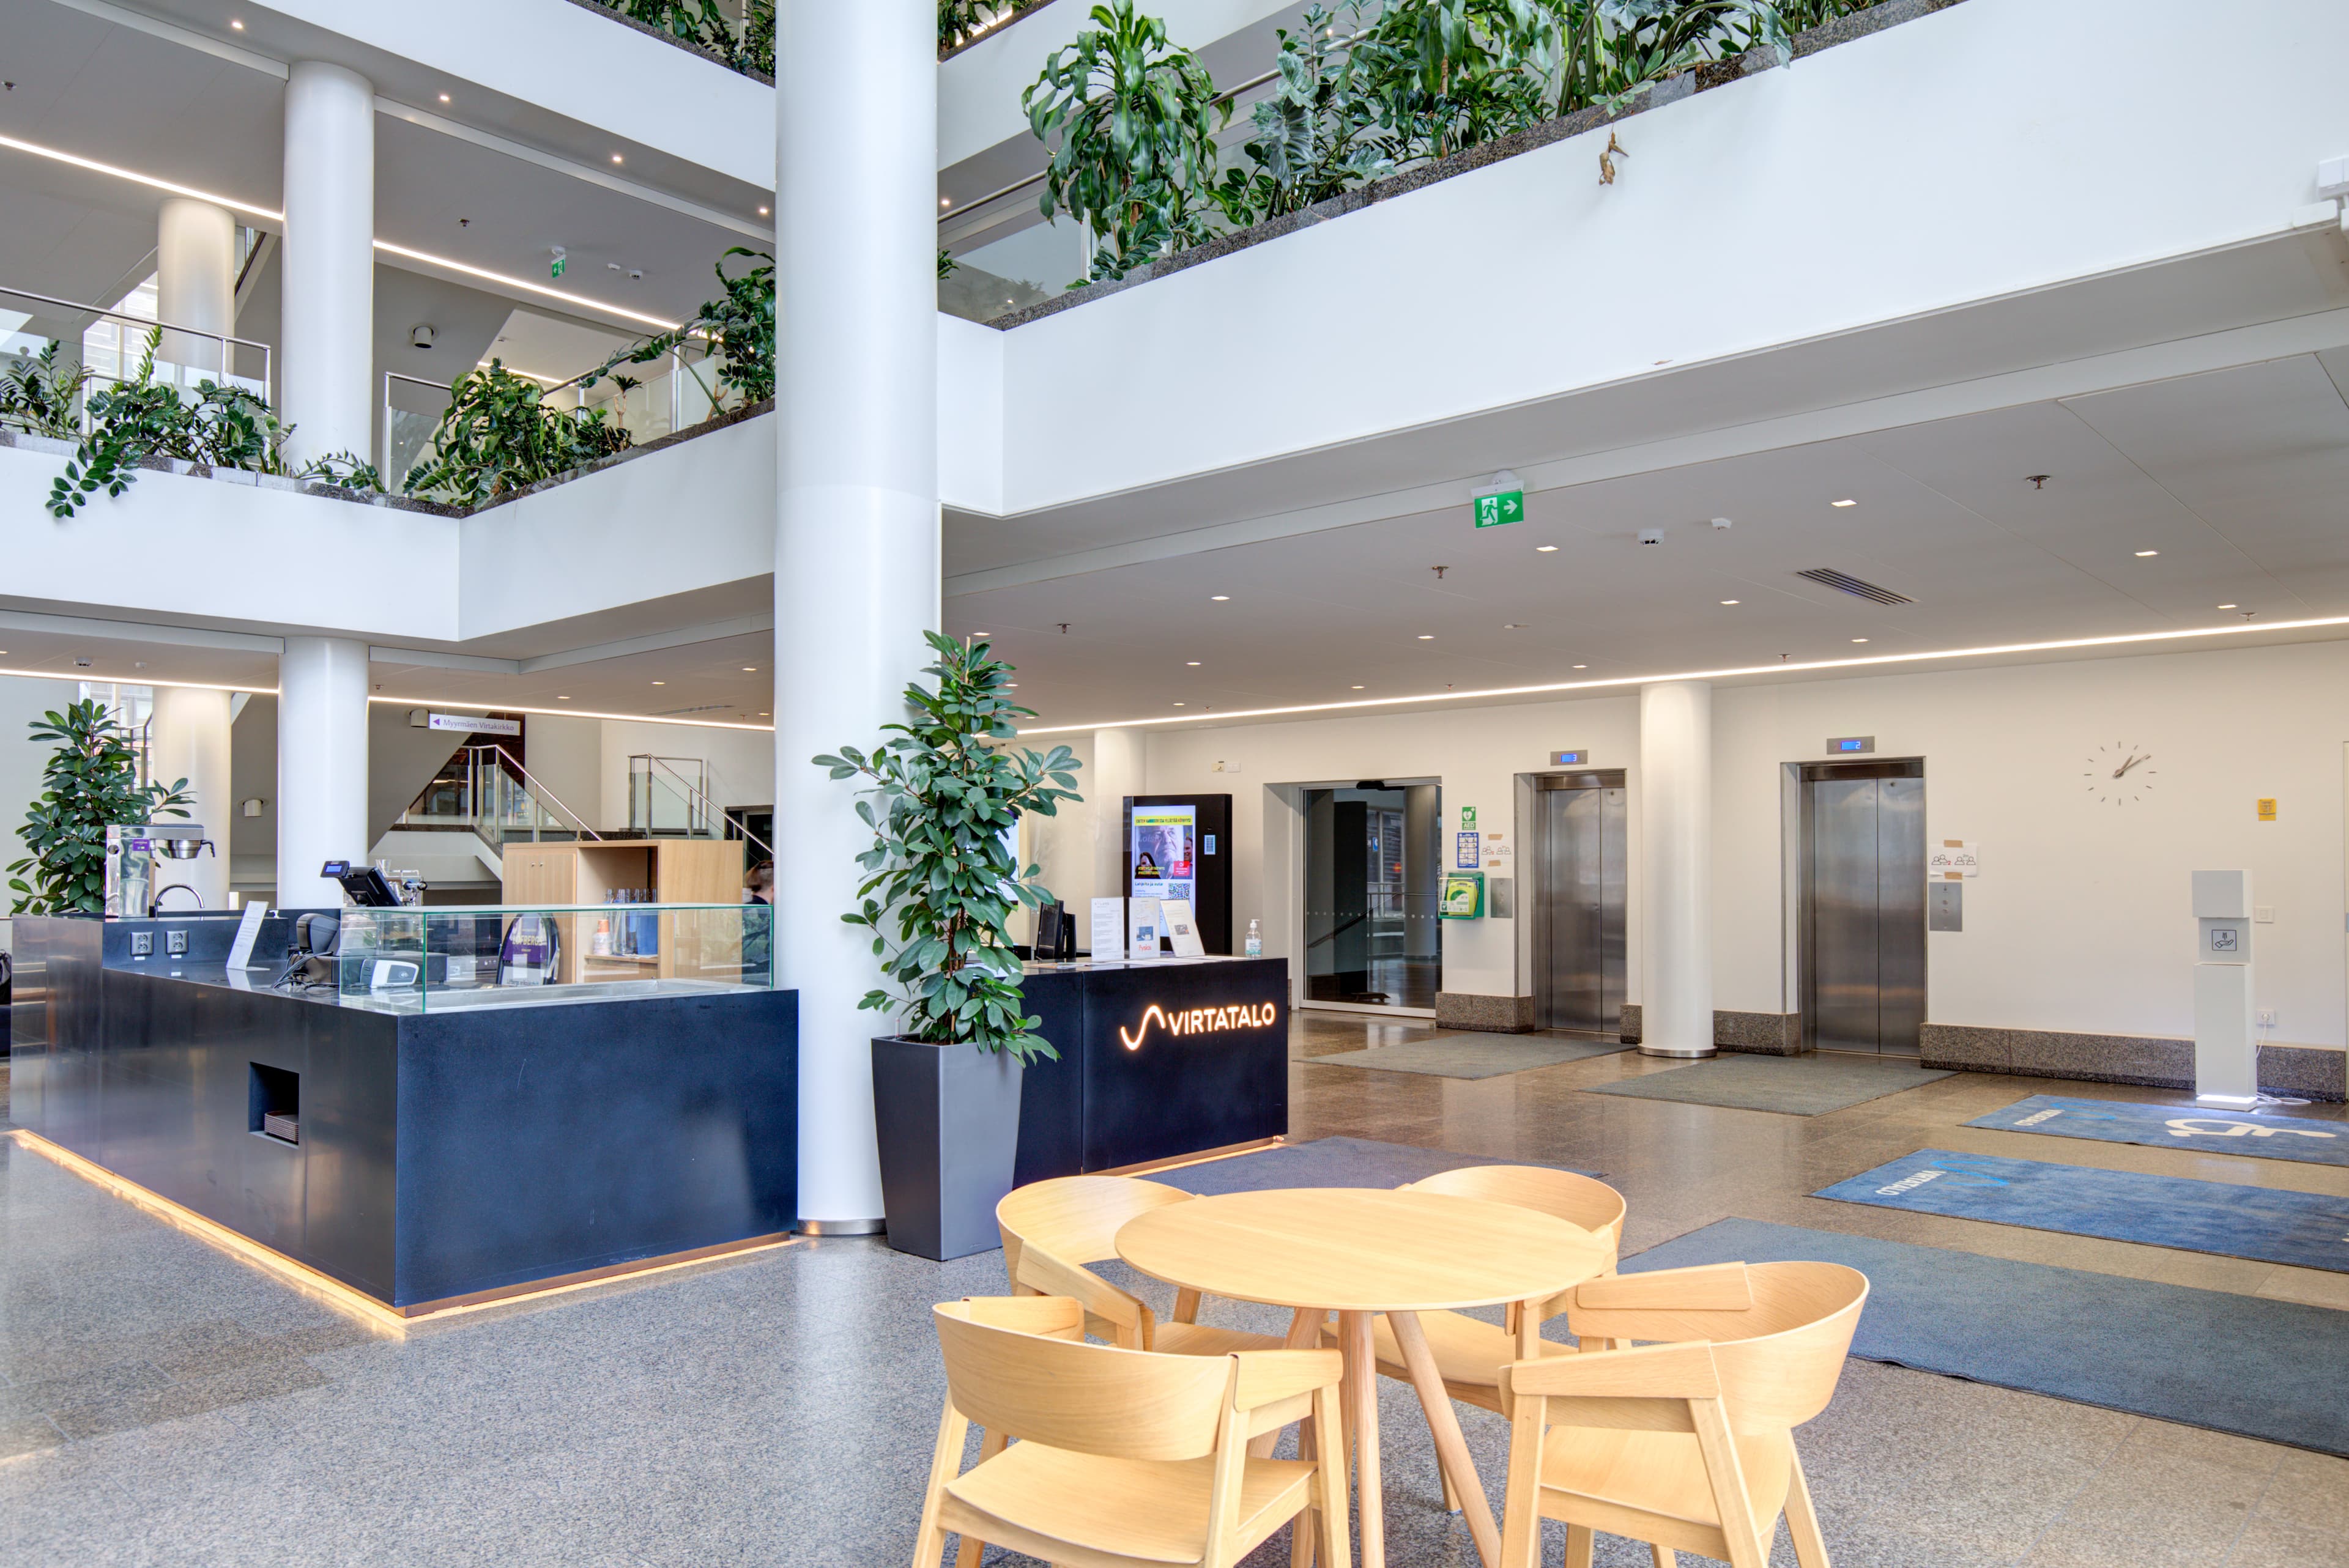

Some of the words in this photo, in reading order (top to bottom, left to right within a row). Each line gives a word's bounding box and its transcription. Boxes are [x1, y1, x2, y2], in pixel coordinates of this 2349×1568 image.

[443, 719, 478, 728] Myyrmäen
[479, 722, 514, 731] Virtakirkko
[1855, 741, 1861, 749] 2
[1168, 1002, 1276, 1036] VIRTATALO
[1875, 1170, 1946, 1196] VIRTATALO
